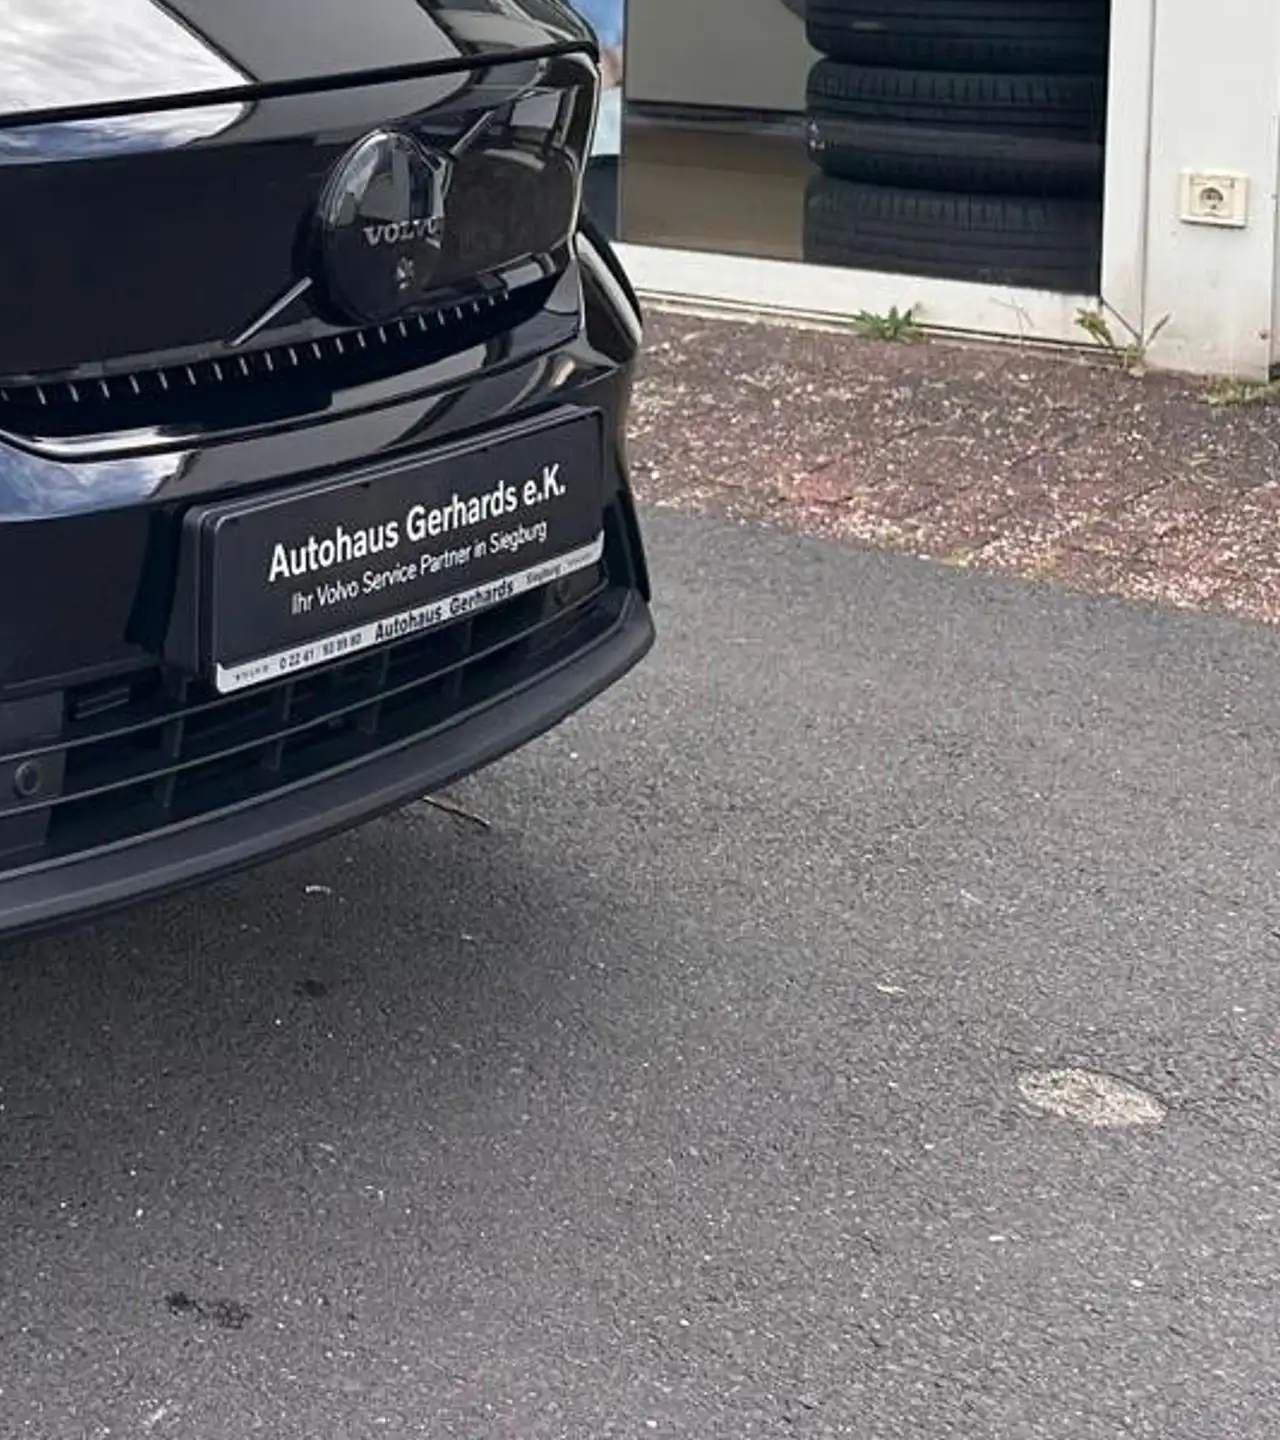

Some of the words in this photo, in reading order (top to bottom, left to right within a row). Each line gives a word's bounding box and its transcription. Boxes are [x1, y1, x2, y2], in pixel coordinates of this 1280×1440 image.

[268, 521, 399, 582] Autohaus
[406, 480, 518, 542] Gerhards
[523, 463, 567, 505] e.K.
[292, 592, 314, 615] Ihr
[315, 580, 359, 606] Volvo
[362, 562, 417, 593] Service
[420, 545, 471, 575] Partner
[474, 539, 487, 558] in
[490, 521, 547, 553] Siegburg
[375, 607, 442, 642] Autohaus
[449, 580, 514, 615] Gerhards
